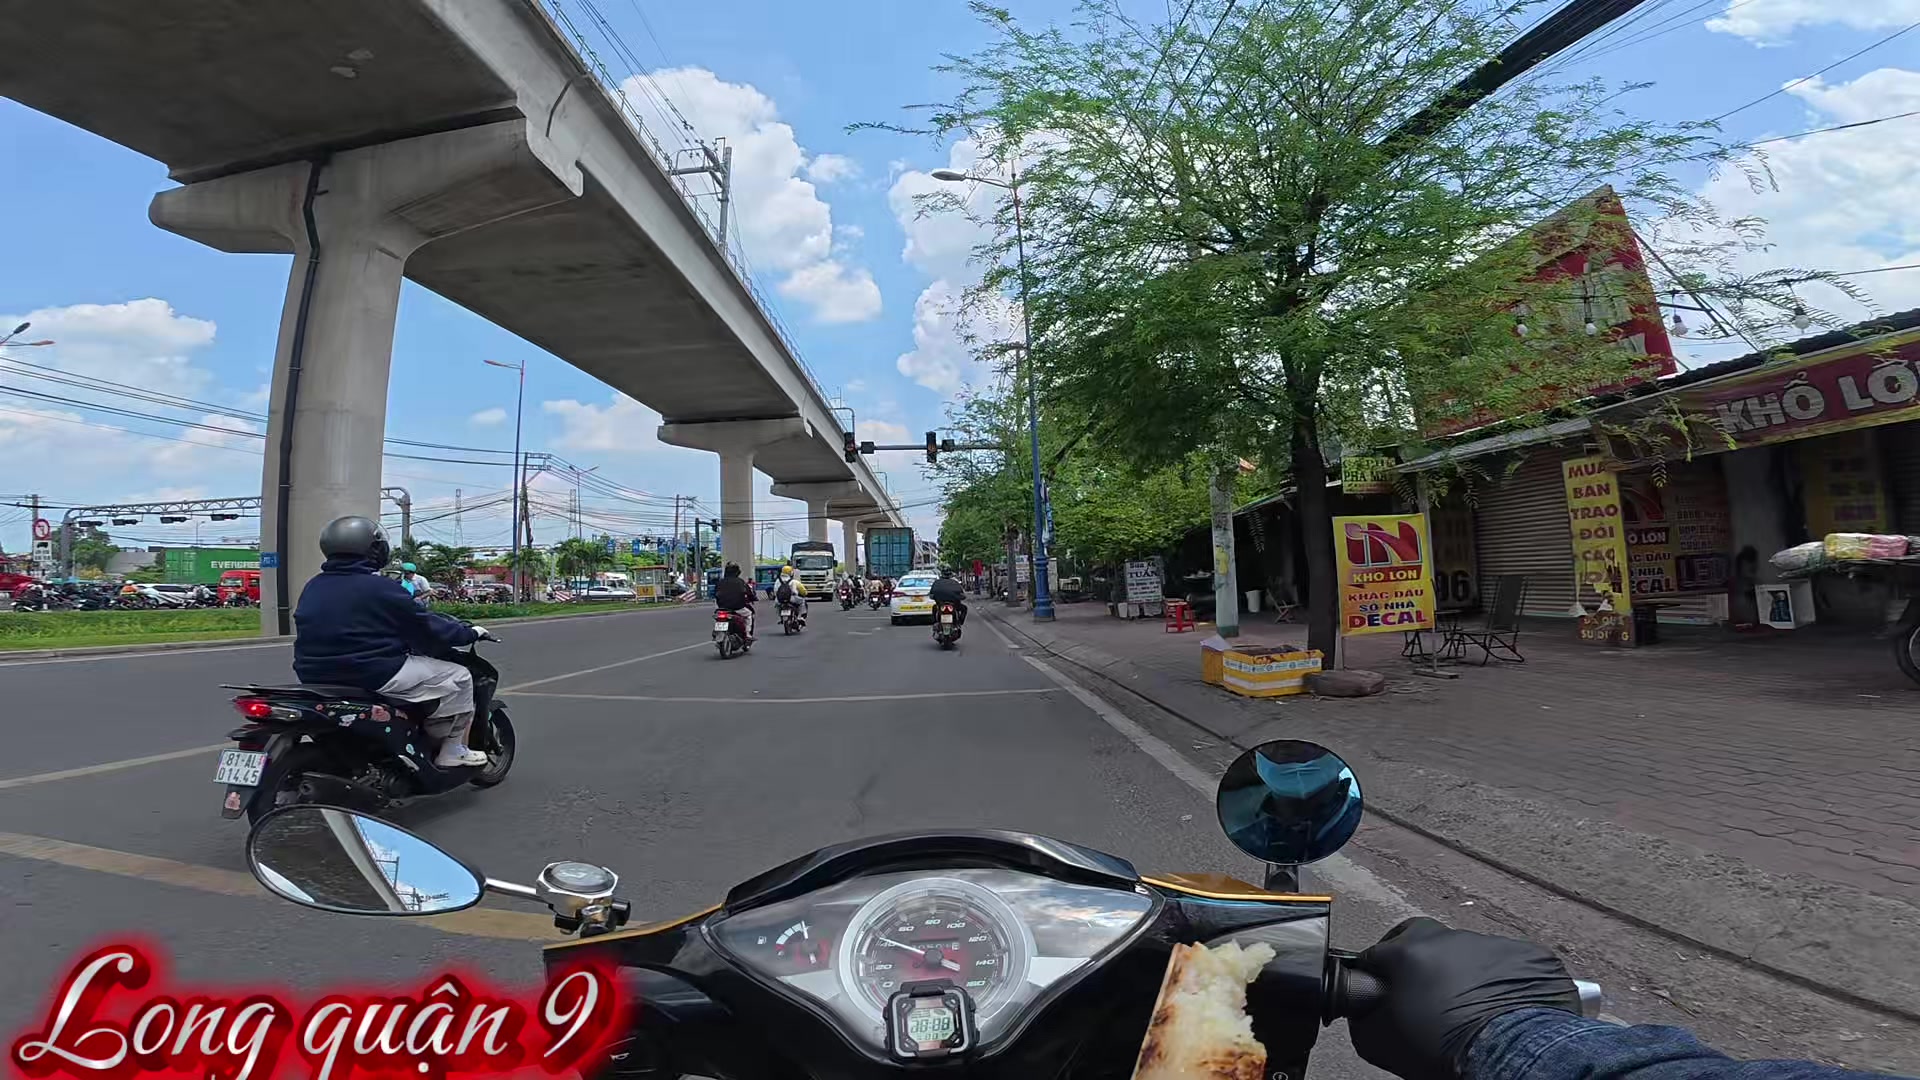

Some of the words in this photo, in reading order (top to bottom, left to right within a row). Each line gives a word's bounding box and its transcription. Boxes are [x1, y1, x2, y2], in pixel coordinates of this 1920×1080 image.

[1716, 371, 1825, 434] KHỔ
[1568, 462, 1608, 479] MUA
[1570, 503, 1619, 520] TRAO
[211, 560, 261, 569] EVERGREE
[1348, 610, 1428, 629] DECAL
[226, 752, 257, 769] 81-AL
[217, 767, 260, 784] 014.45
[946, 921, 966, 929] 100
[975, 959, 996, 967] 140
